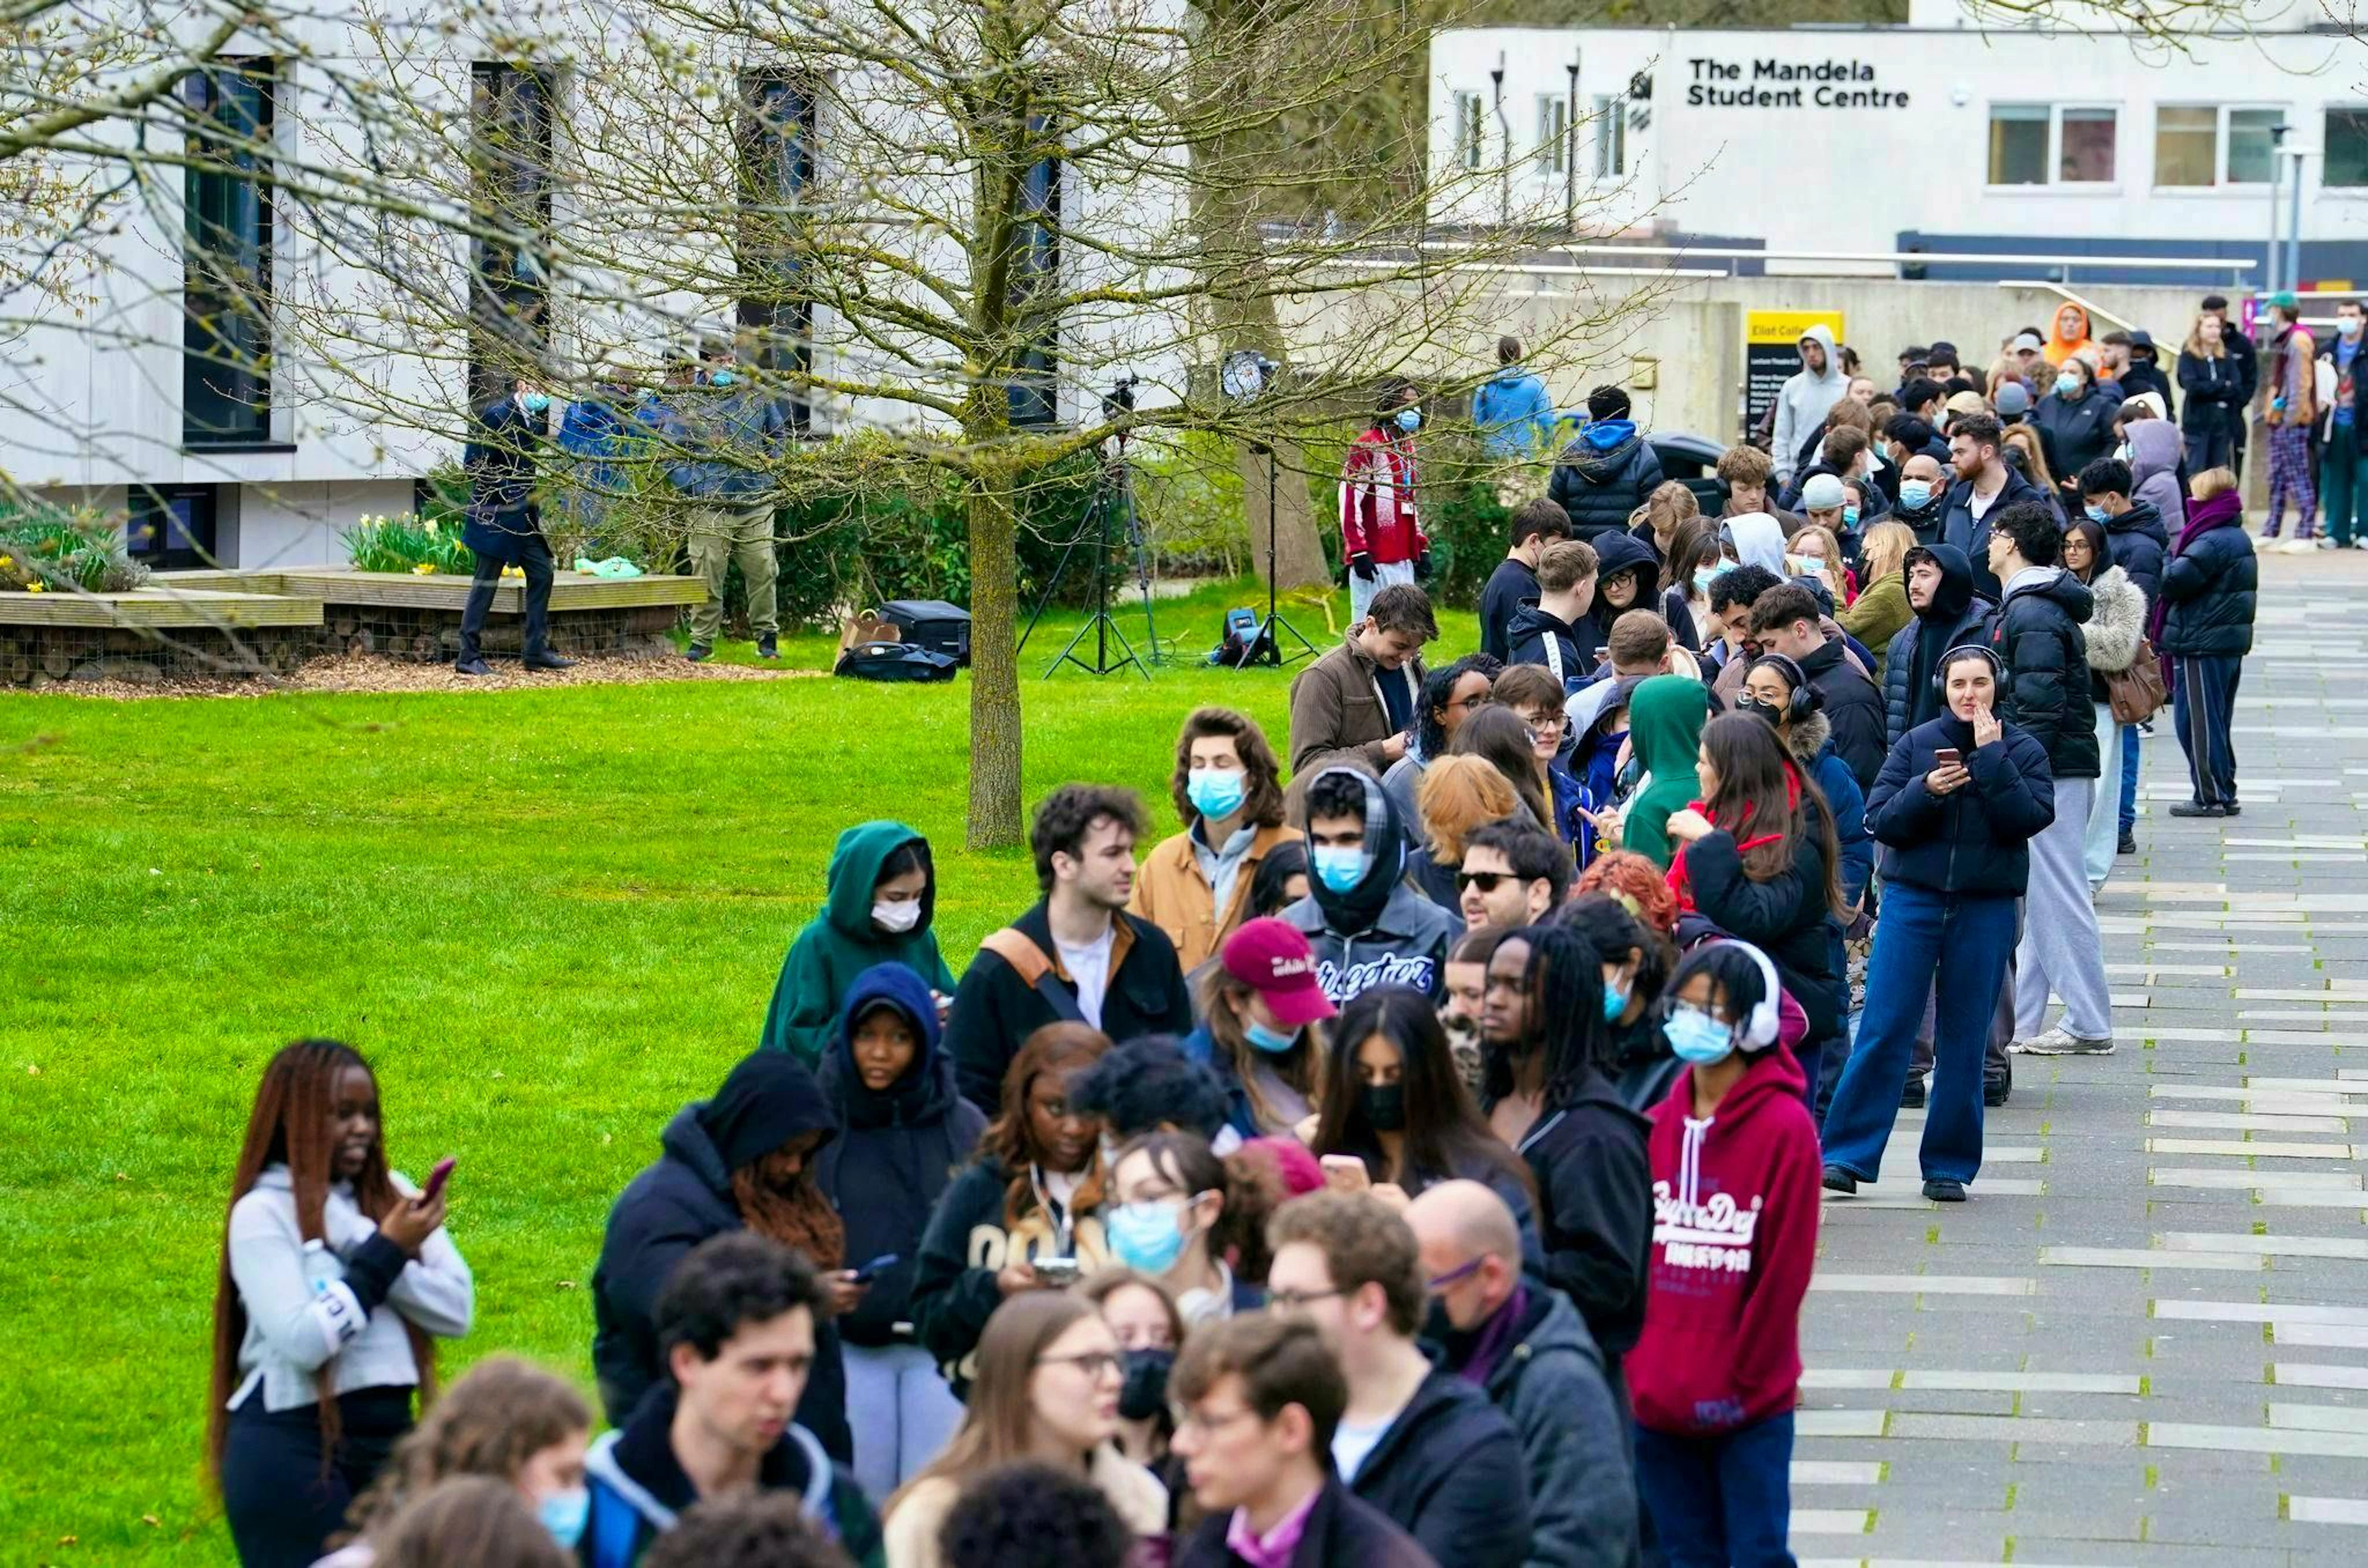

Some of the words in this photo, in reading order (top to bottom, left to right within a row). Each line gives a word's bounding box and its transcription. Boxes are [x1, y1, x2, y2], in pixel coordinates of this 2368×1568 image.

[1688, 59, 1740, 80] The
[1753, 59, 1874, 81] Mandela
[1687, 84, 1801, 107] Student
[1814, 86, 1909, 107] Centre
[1779, 325, 1806, 336] Colle
